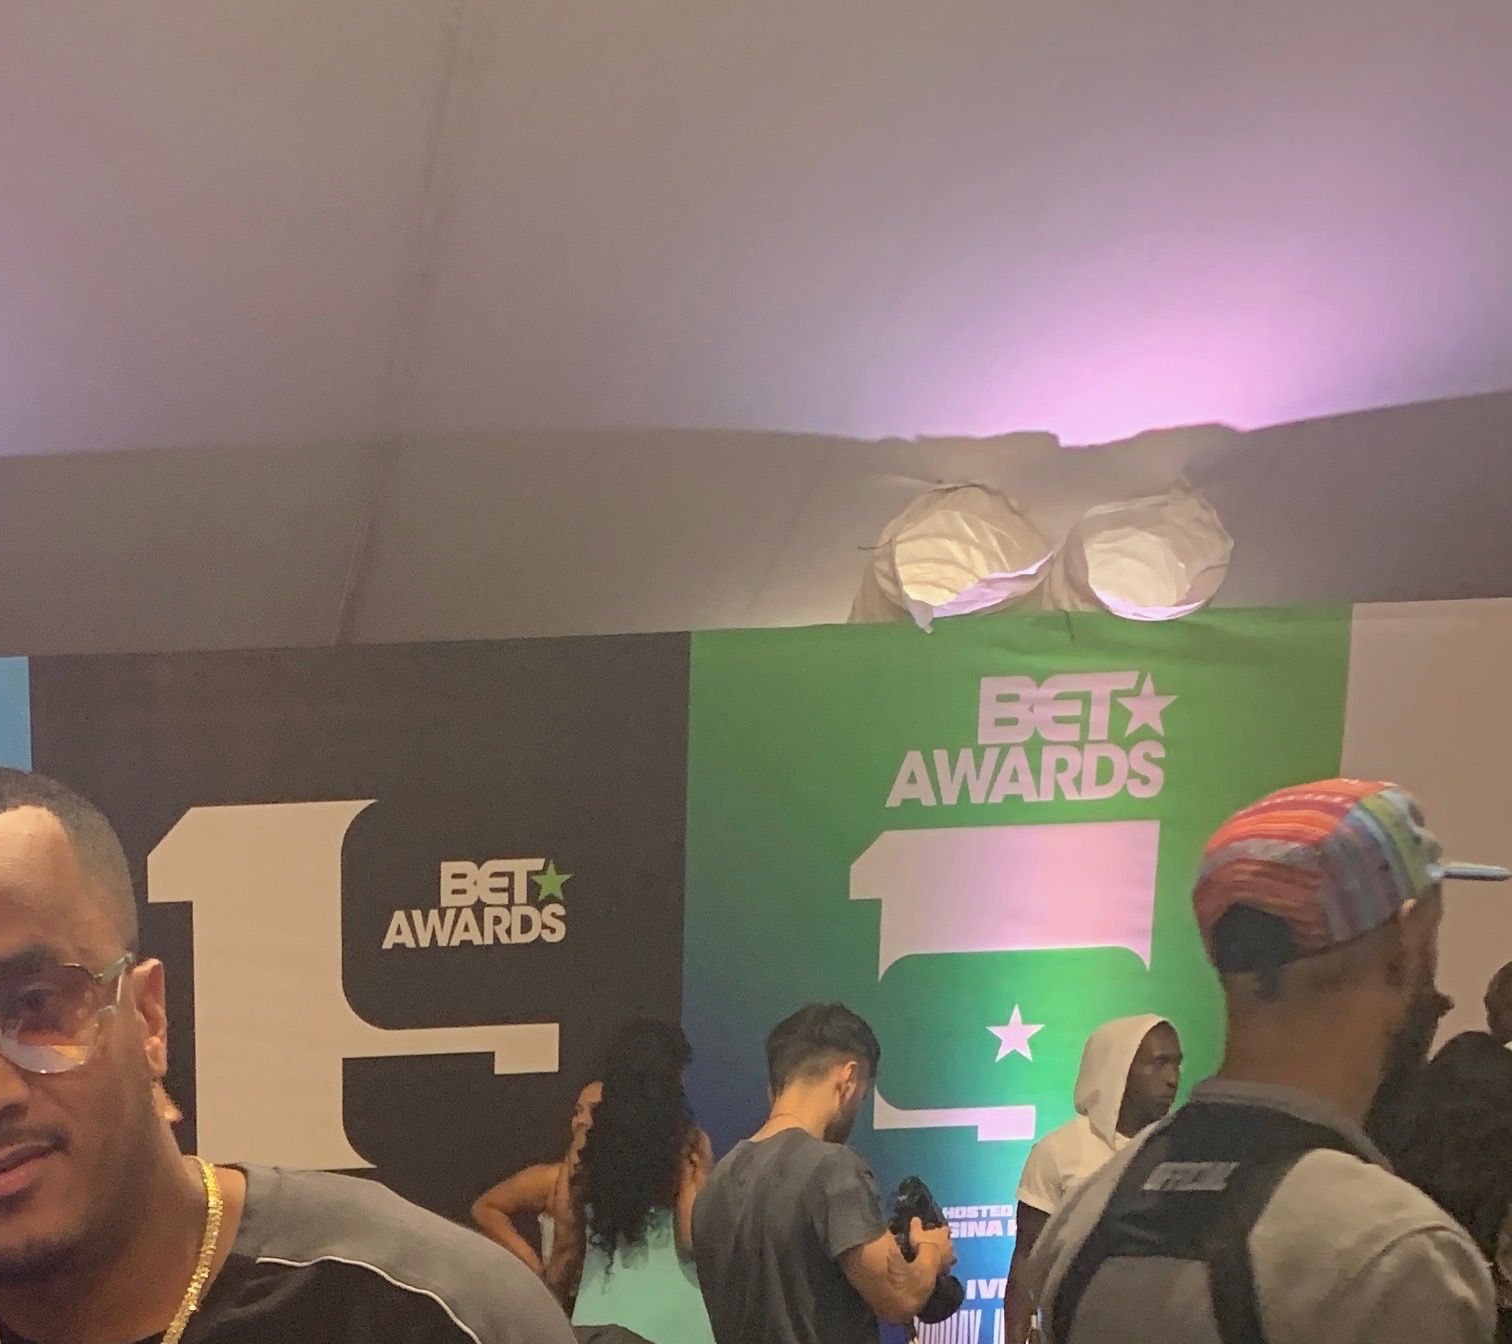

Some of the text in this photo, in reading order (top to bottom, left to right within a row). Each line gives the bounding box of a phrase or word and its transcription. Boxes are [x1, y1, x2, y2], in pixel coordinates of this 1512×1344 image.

[978, 670, 1139, 745] BET
[885, 740, 1166, 807] AWARDS
[440, 858, 545, 907] BET
[382, 902, 567, 949] AWARDS
[942, 1205, 1012, 1218] HOSTED
[950, 1220, 1004, 1238] GINA
